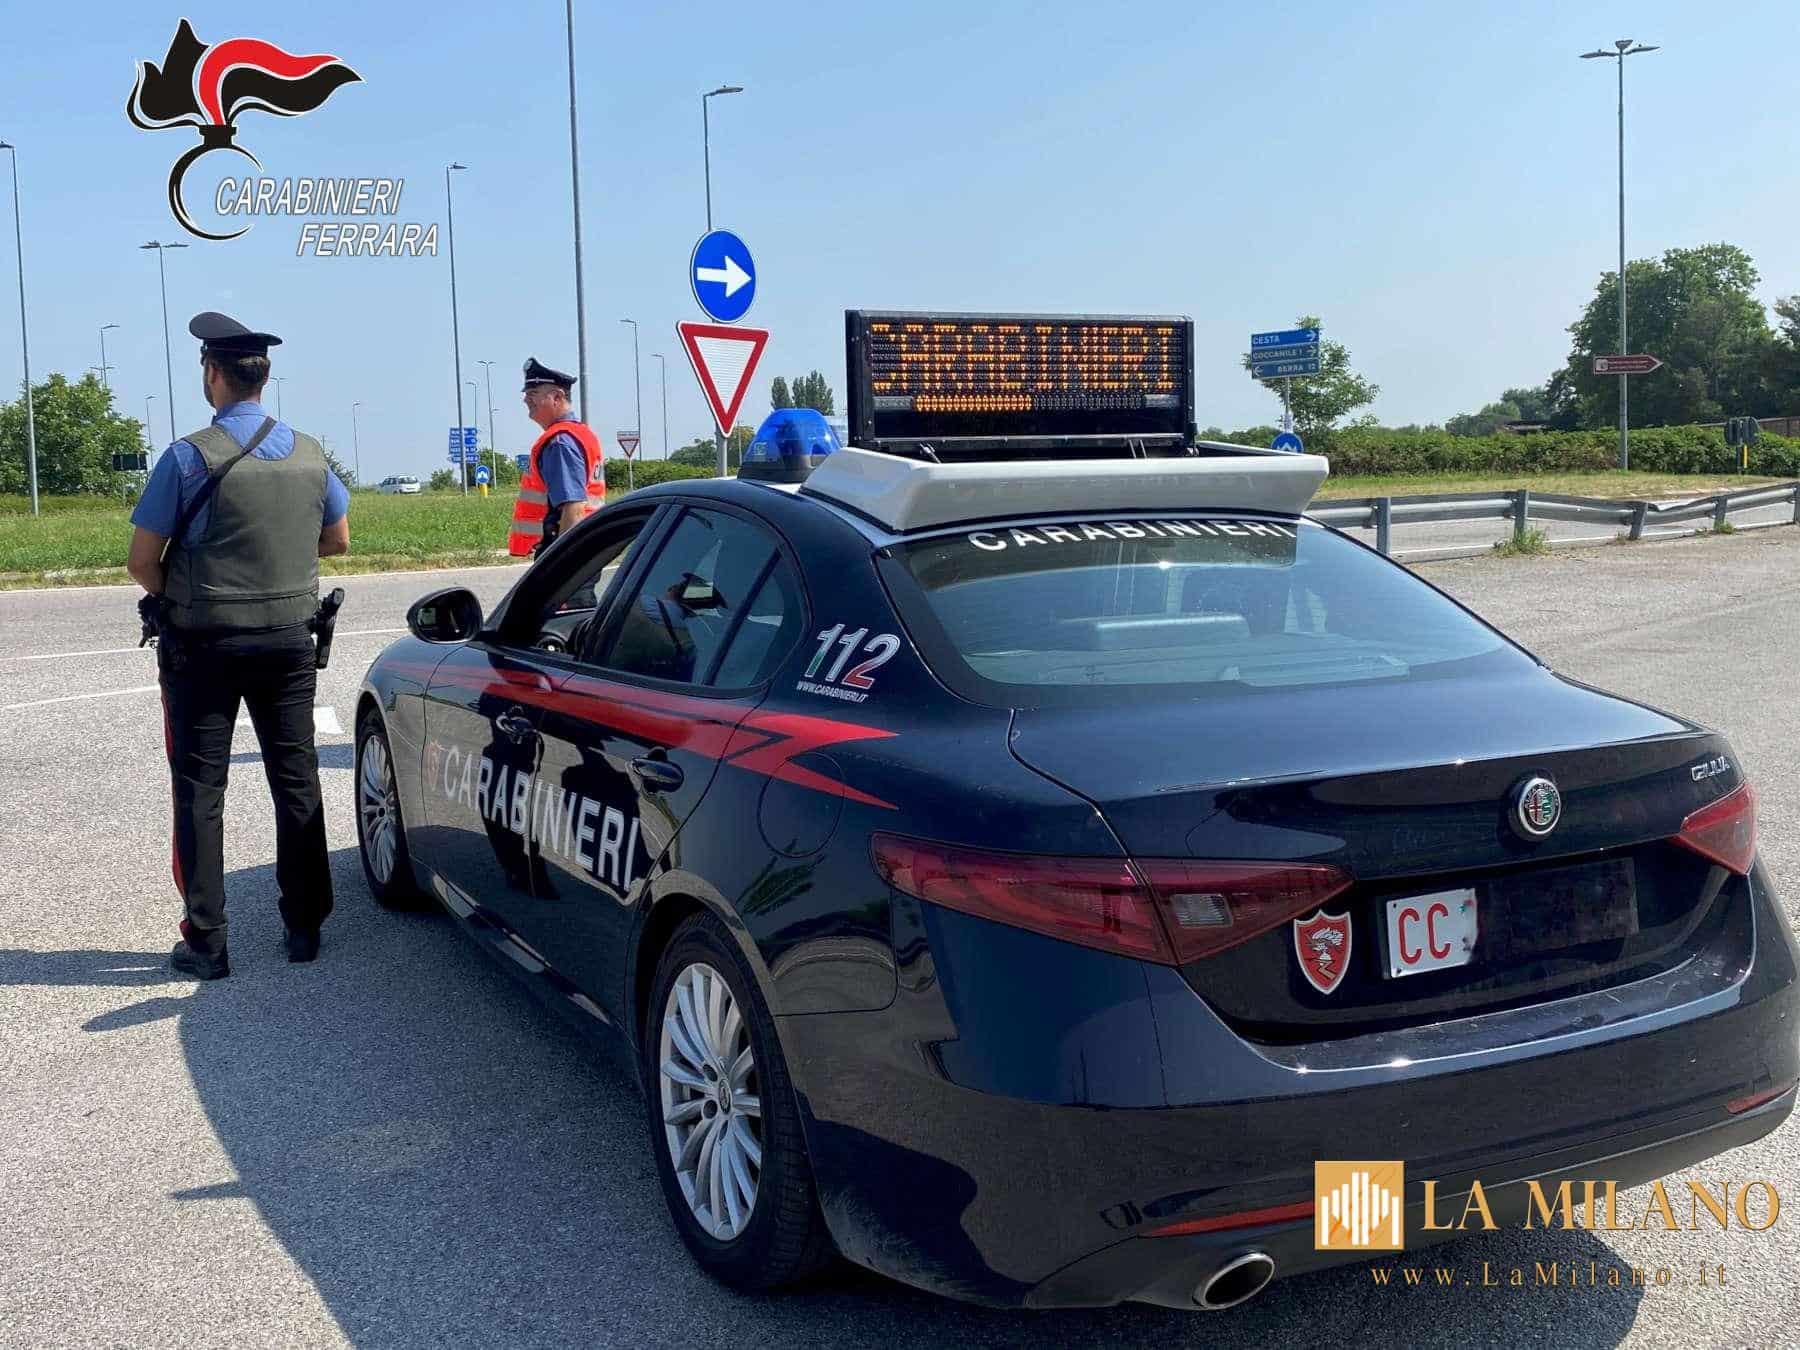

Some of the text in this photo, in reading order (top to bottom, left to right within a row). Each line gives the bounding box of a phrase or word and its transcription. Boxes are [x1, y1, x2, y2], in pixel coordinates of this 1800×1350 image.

[1253, 335, 1280, 345] CESTA
[967, 520, 1297, 552] CARABINIERI
[804, 623, 901, 690] 112
[443, 745, 640, 893] CARABINIERI
[1398, 902, 1451, 966] CC
